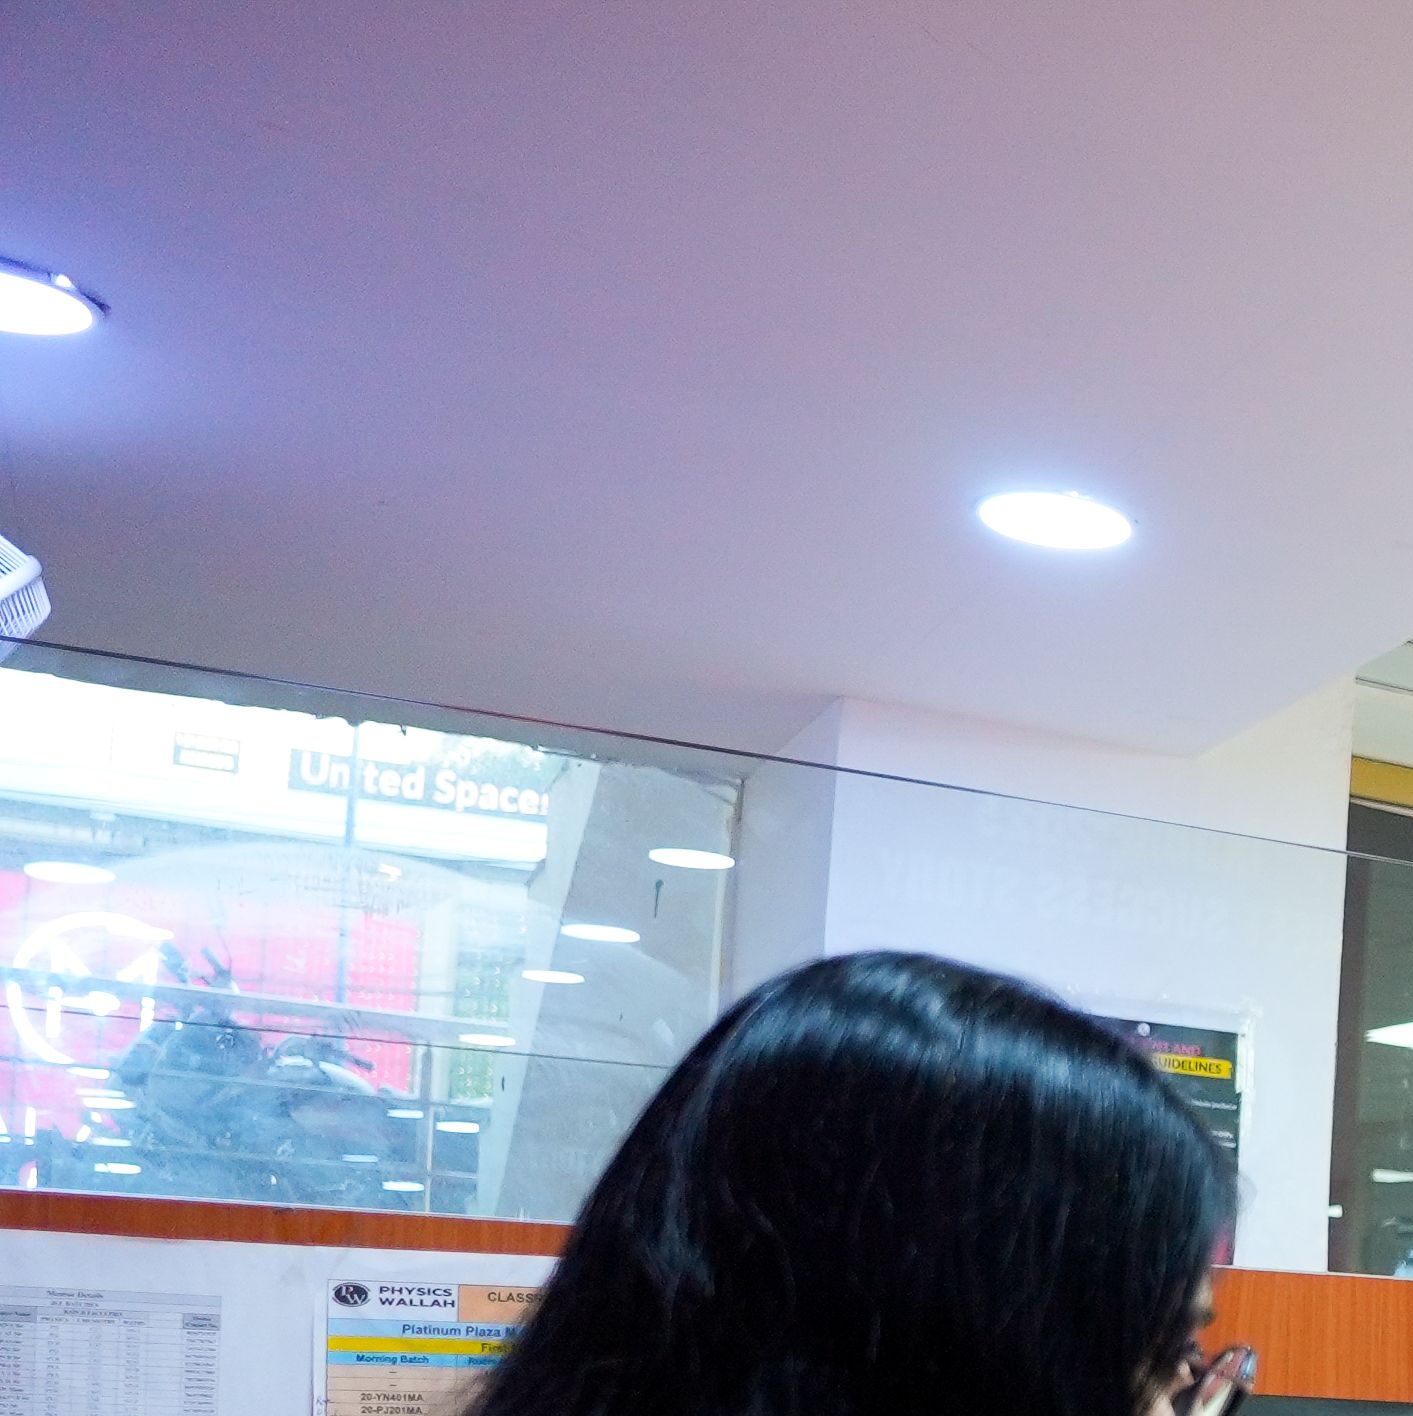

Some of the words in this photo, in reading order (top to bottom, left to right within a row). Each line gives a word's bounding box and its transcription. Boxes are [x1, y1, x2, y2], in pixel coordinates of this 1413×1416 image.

[299, 750, 426, 801] Unted
[379, 1285, 453, 1297] PHYSICS
[379, 1297, 456, 1308] WALLAH
[402, 1324, 461, 1337] Platinum
[465, 1326, 501, 1338] Plaza
[356, 1354, 398, 1364] Morning
